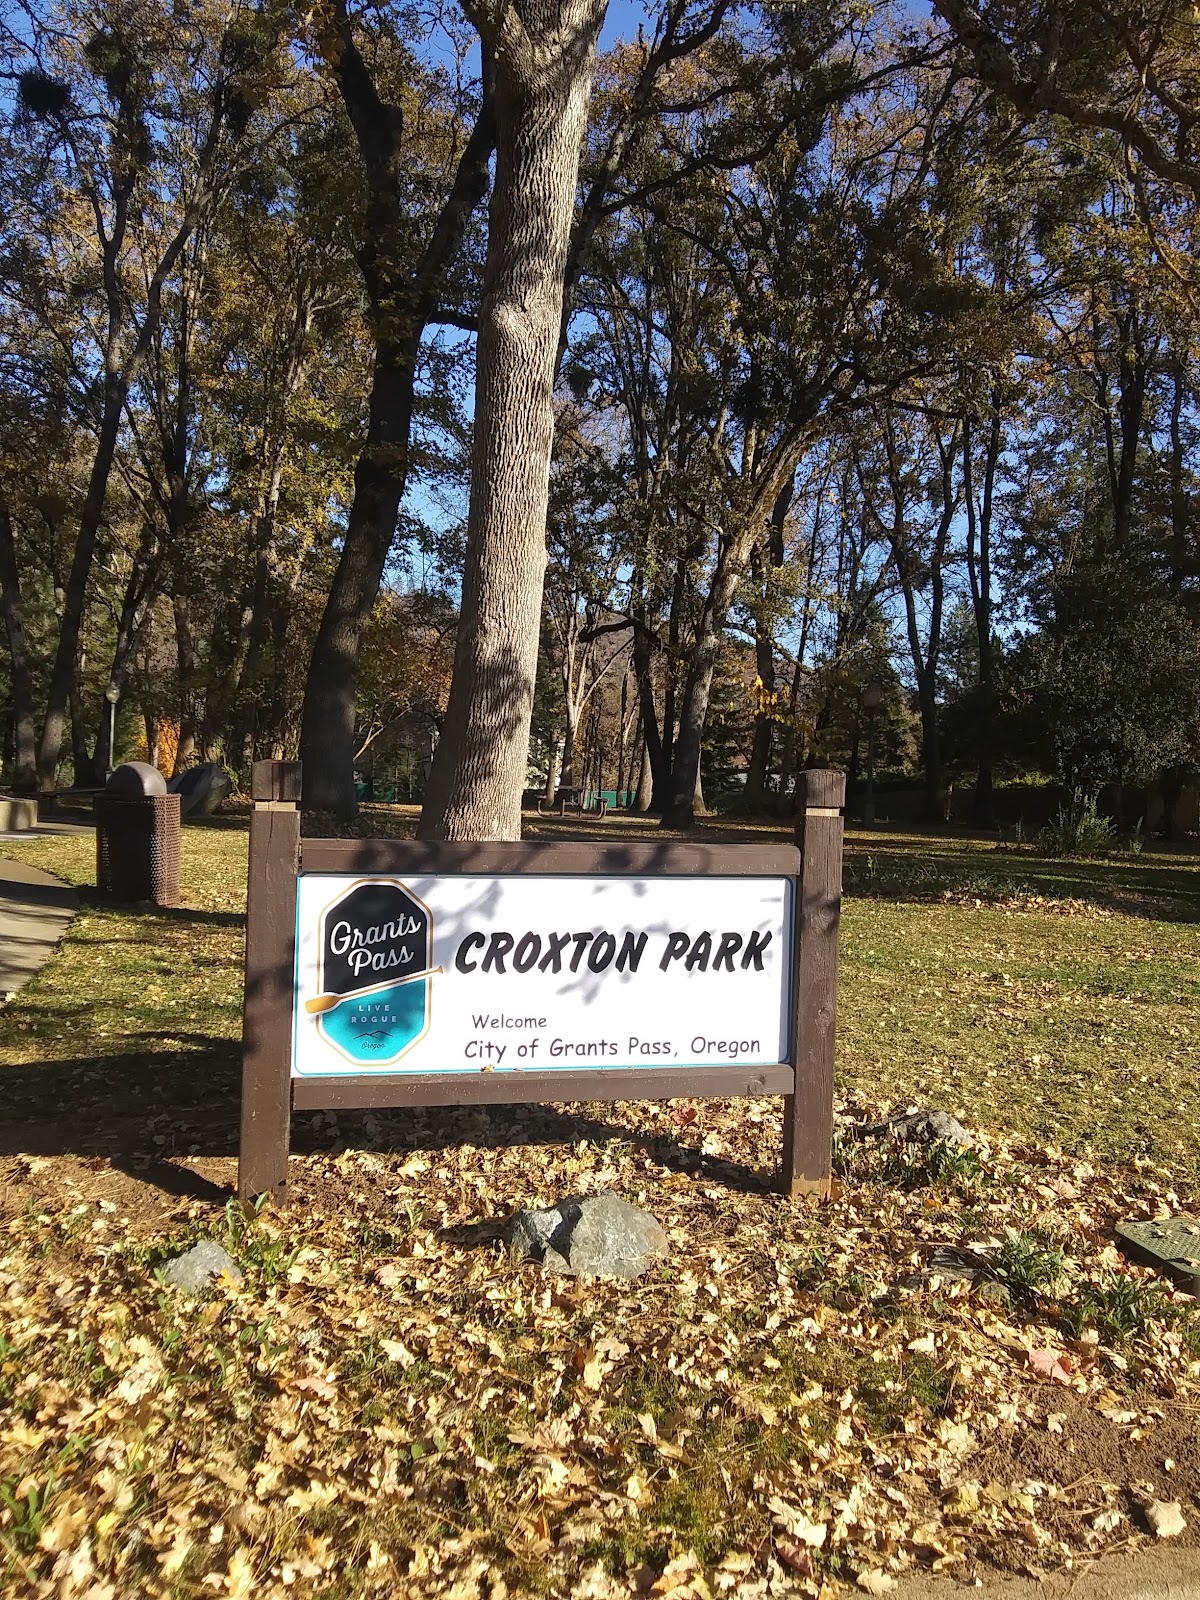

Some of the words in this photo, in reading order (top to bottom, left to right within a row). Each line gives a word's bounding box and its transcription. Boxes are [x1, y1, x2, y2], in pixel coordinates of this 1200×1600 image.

[330, 912, 422, 955] Grants
[347, 945, 415, 977] Pass
[454, 931, 649, 975] CROXTON
[658, 930, 773, 972] PARK
[358, 1004, 391, 1012] LIVE
[351, 1015, 397, 1023] ROGUE
[471, 1013, 548, 1029] Welcome
[361, 1041, 386, 1051] Oregon
[464, 1040, 505, 1063] City
[516, 1039, 538, 1059] of
[549, 1039, 619, 1058] Grants
[628, 1037, 679, 1058] Pass,
[690, 1036, 762, 1058] Oregon
